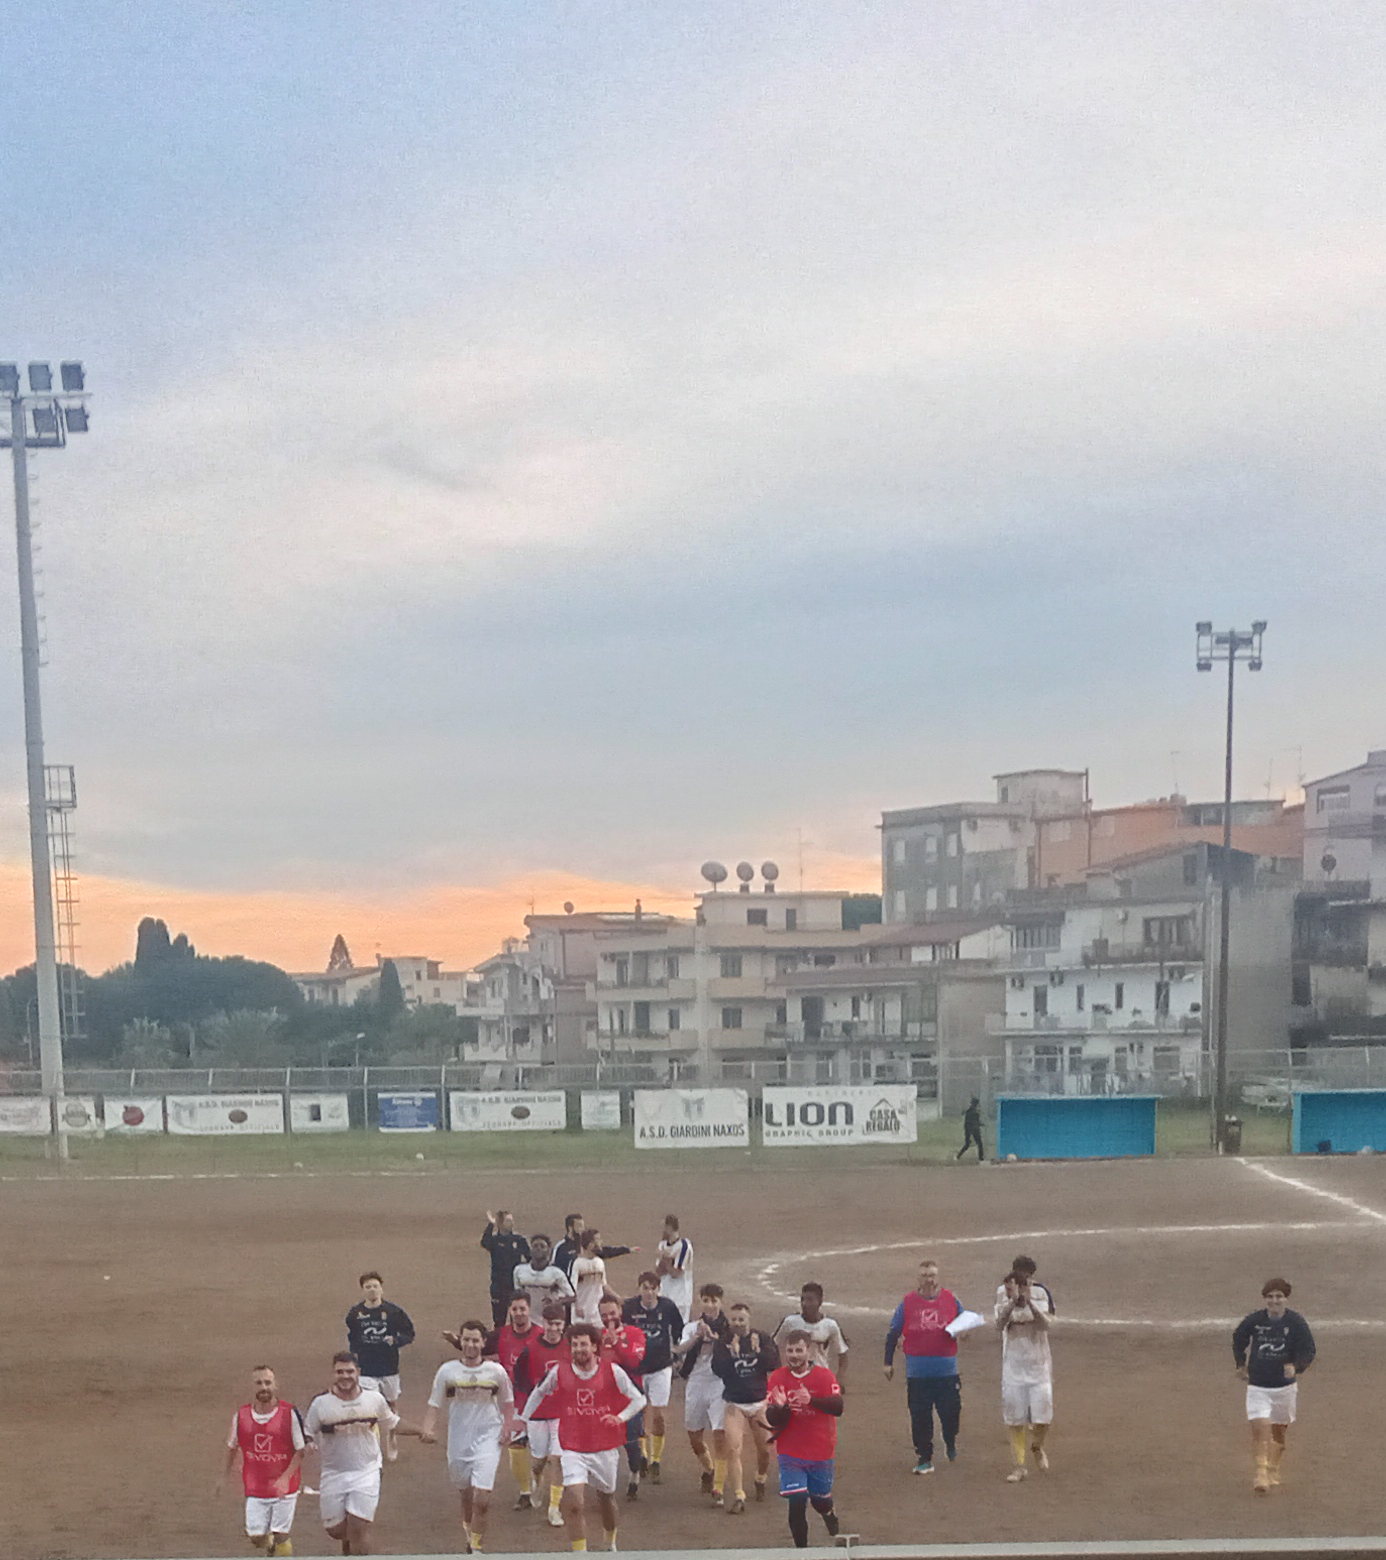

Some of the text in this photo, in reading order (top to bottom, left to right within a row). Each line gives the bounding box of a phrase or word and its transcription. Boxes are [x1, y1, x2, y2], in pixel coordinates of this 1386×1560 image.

[639, 1123, 745, 1139] A.S.D. GIARDINI NAXOS
[818, 1128, 854, 1137] GROUP
